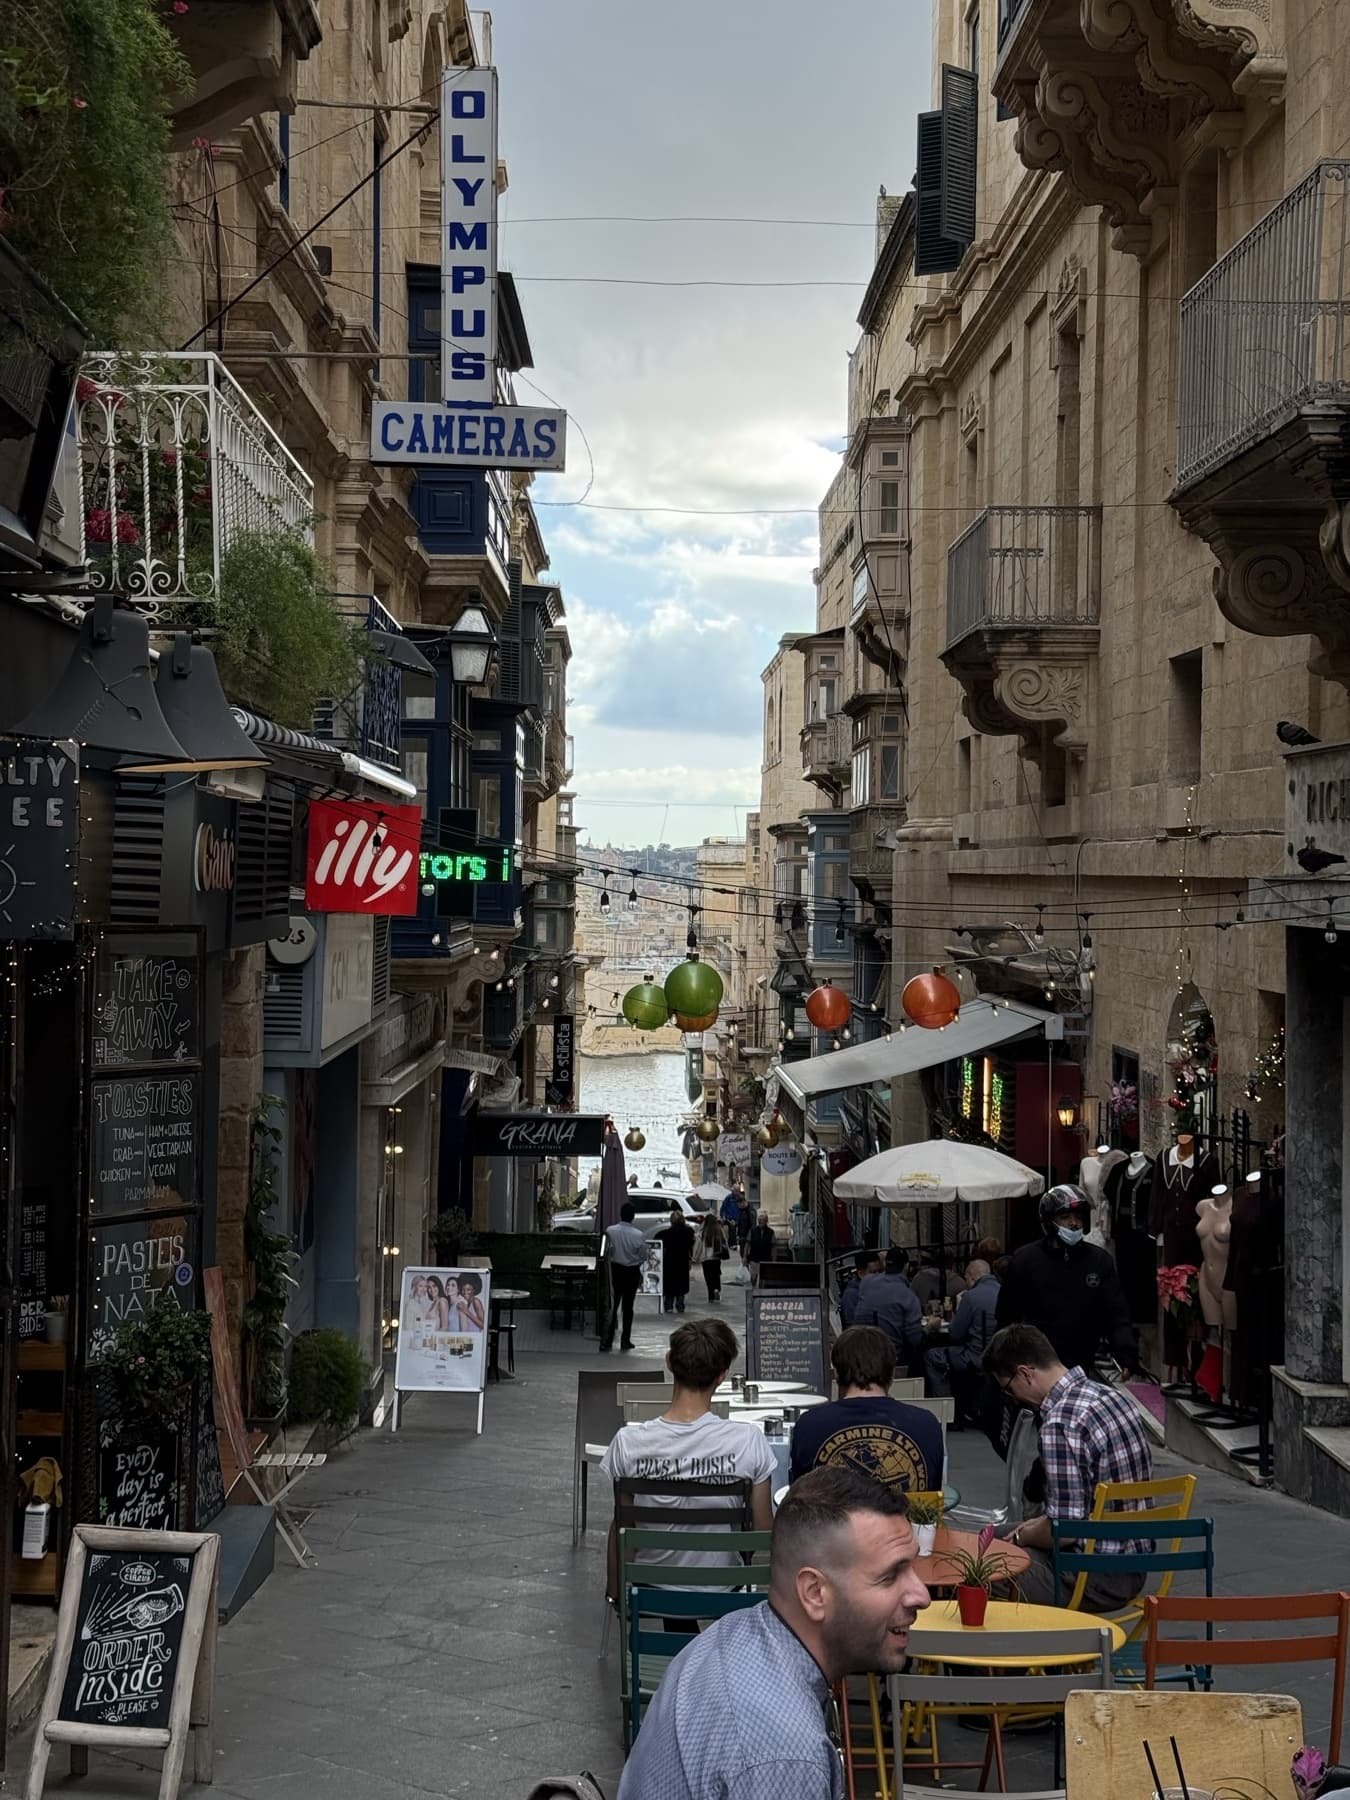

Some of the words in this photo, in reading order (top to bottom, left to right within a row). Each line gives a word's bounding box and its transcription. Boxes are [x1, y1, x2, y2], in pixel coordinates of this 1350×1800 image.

[449, 90, 487, 380] OLYMPUS
[381, 412, 557, 458] CAMERAS
[314, 819, 413, 903] illy
[114, 959, 177, 1002] TAKE
[112, 1002, 178, 1050] AWAY
[93, 1079, 193, 1123] TOASTIES
[112, 1127, 135, 1141] TUNA
[146, 1139, 192, 1159] VEGETARIAN
[499, 1120, 578, 1151] GRANA
[112, 1146, 134, 1162] CRAB
[148, 1161, 176, 1177] VEGAN
[99, 1167, 131, 1183] CHICKEN
[103, 1234, 184, 1277] PASTEIS
[131, 1273, 151, 1290] DE
[104, 1285, 181, 1323] NATA
[115, 1445, 160, 1476] Every
[819, 1427, 893, 1463] CARMINE
[895, 1434, 920, 1461] LTD
[116, 1469, 145, 1507] day
[150, 1469, 164, 1489] is
[119, 1492, 166, 1528] perfect
[83, 1631, 172, 1671] ORDER
[117, 1700, 149, 1714] PLEASE
